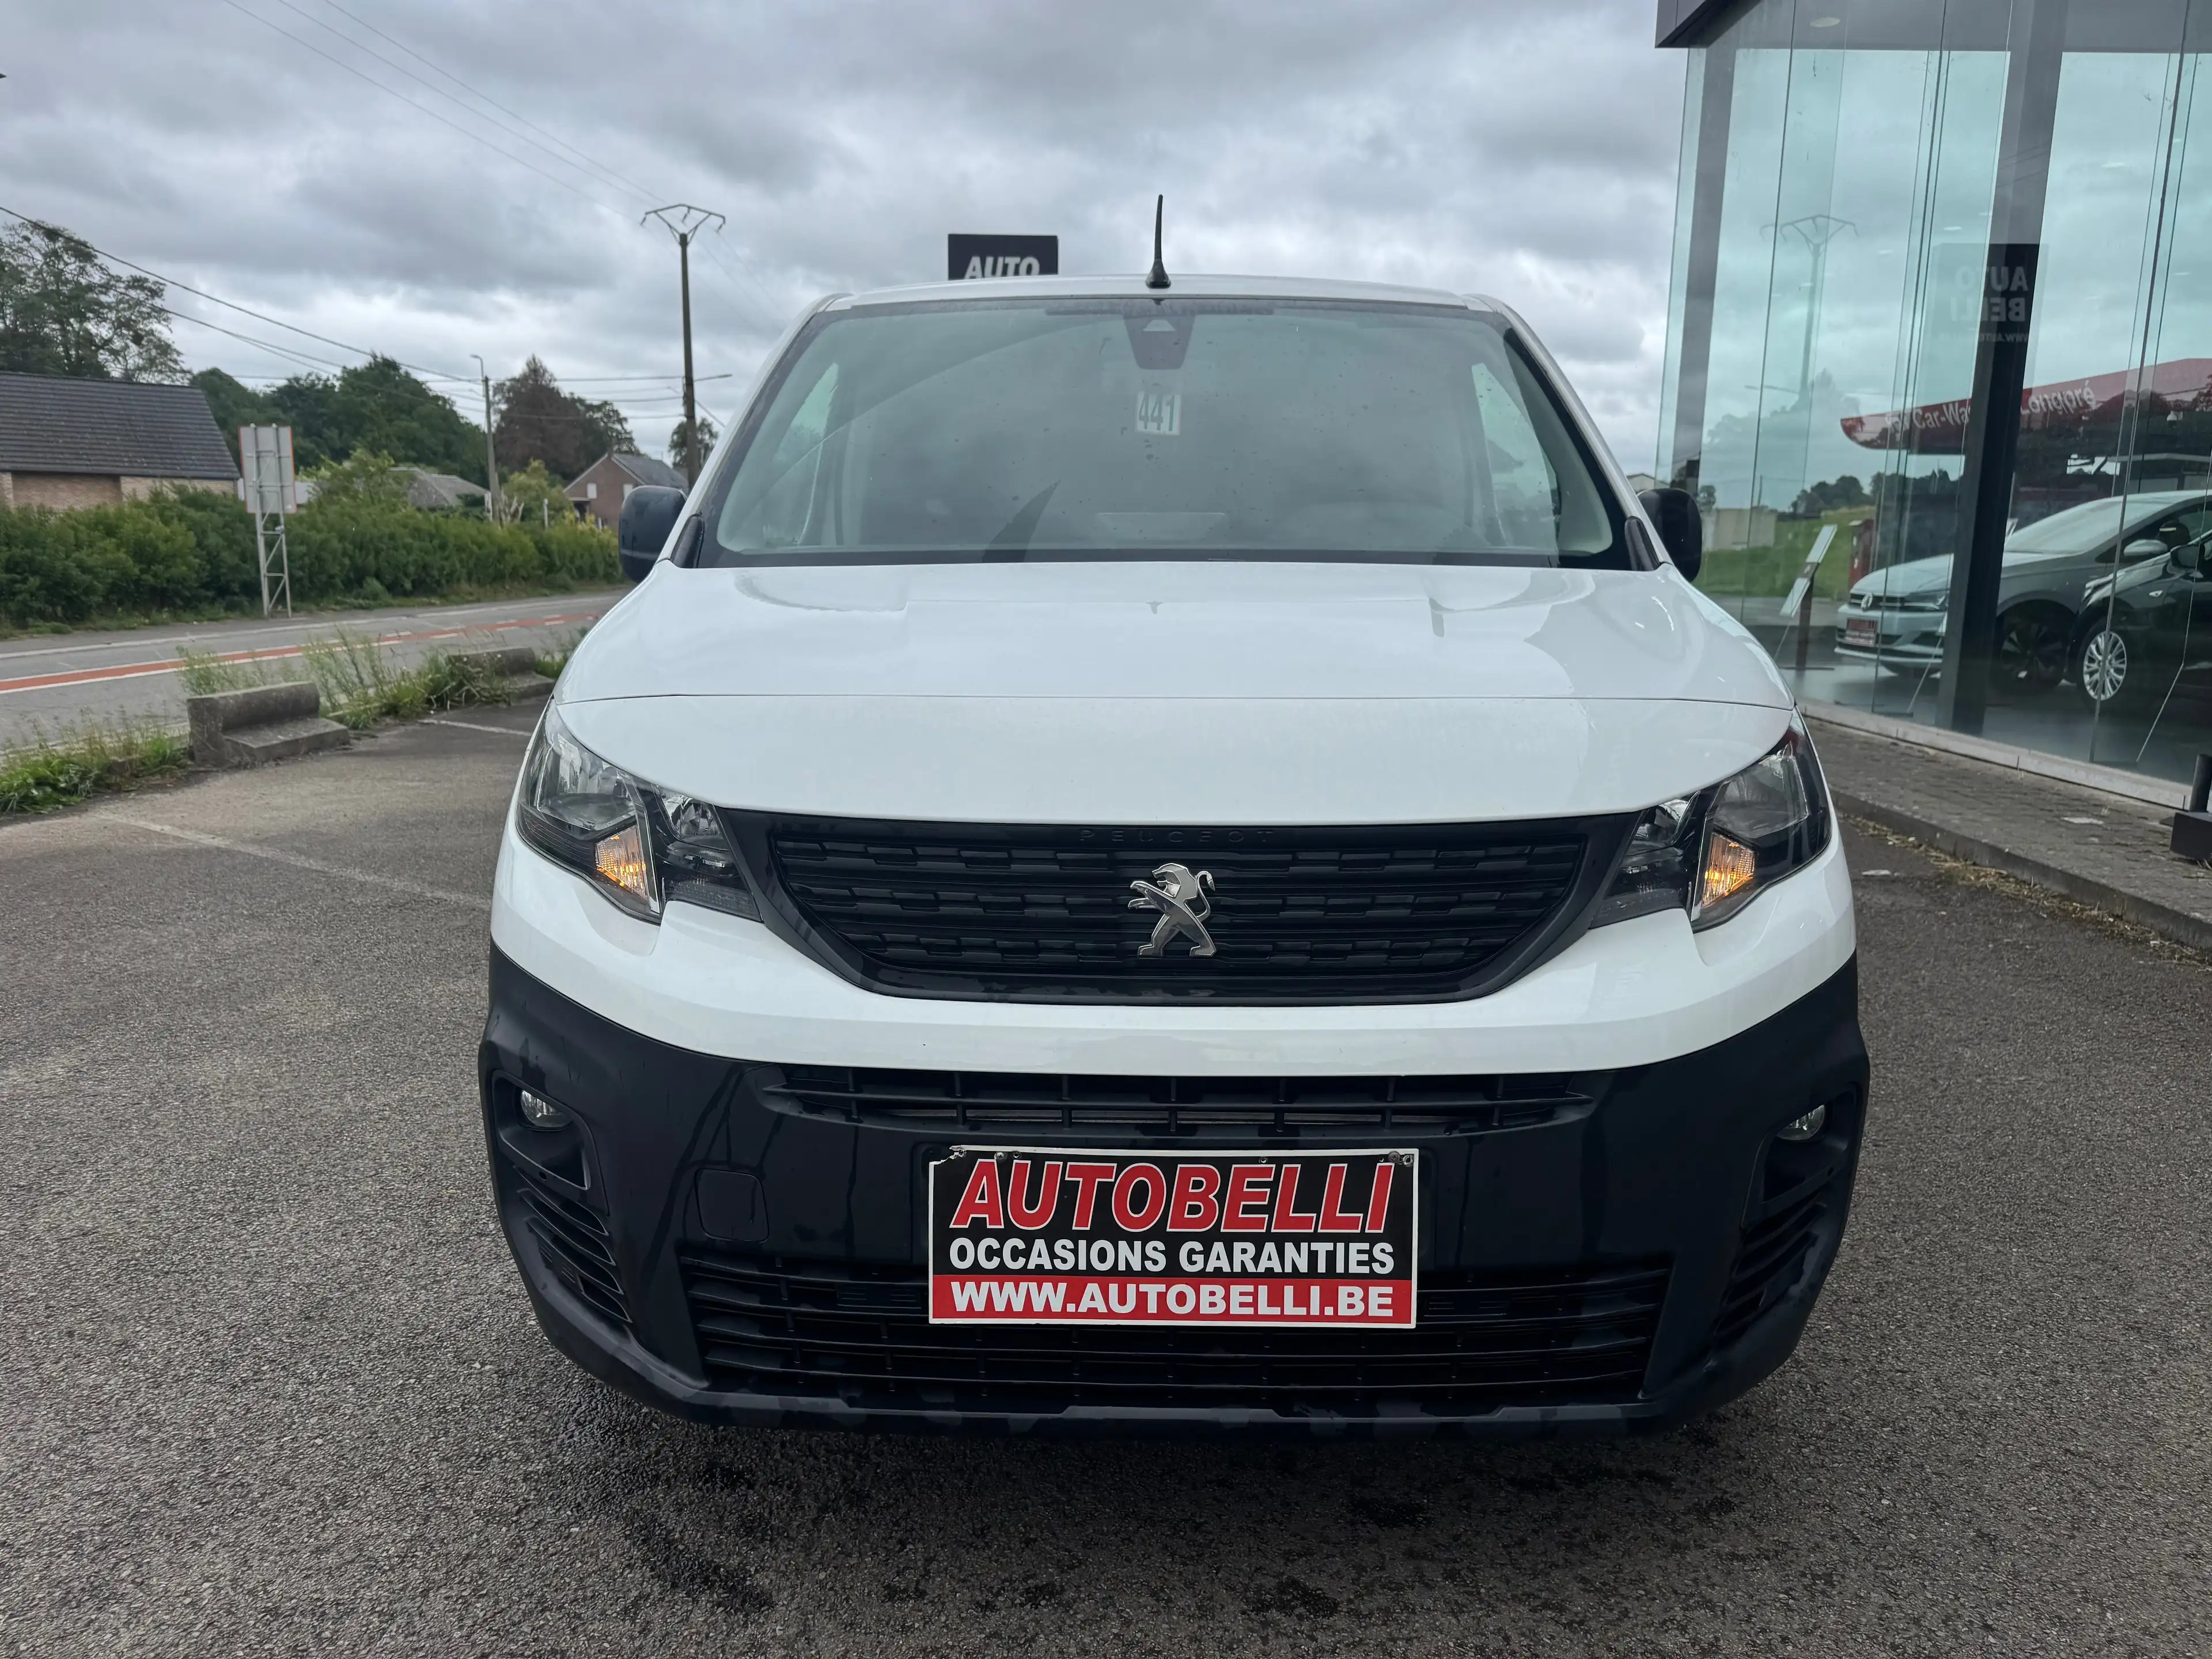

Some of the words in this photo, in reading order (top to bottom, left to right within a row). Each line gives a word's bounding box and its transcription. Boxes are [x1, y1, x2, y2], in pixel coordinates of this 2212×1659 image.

[963, 256, 1040, 279] AUTO
[1138, 393, 1175, 431] 441
[1912, 402, 1971, 429] Car-Wa
[949, 1158, 1395, 1233] AUTOBELLI
[949, 1237, 1166, 1272] OCCASIONS
[1179, 1241, 1394, 1274] GARANTIES
[950, 1282, 1394, 1317] WWW.AUTOBELLI.BE
